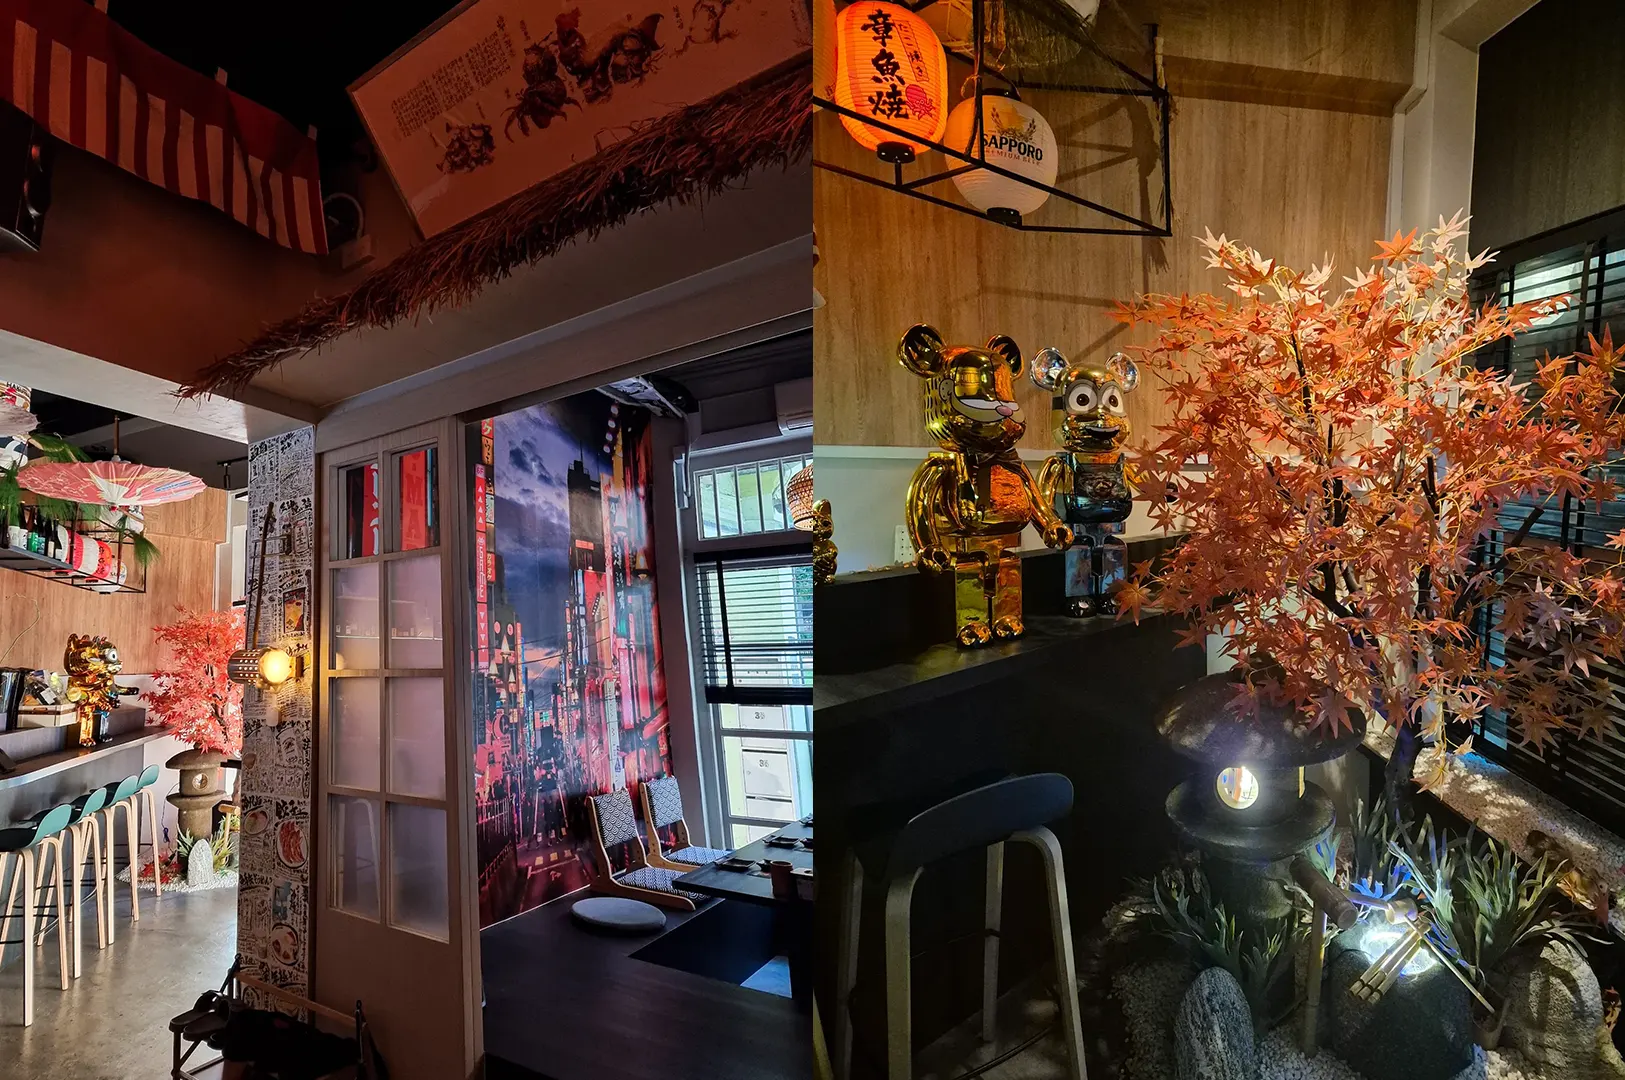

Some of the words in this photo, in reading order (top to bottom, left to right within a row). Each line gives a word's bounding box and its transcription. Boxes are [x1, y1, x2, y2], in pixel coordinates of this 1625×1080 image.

[898, 23, 923, 77] たこ焼き
[983, 133, 1043, 161] SAPPORO
[985, 148, 1020, 161] REMIUM
